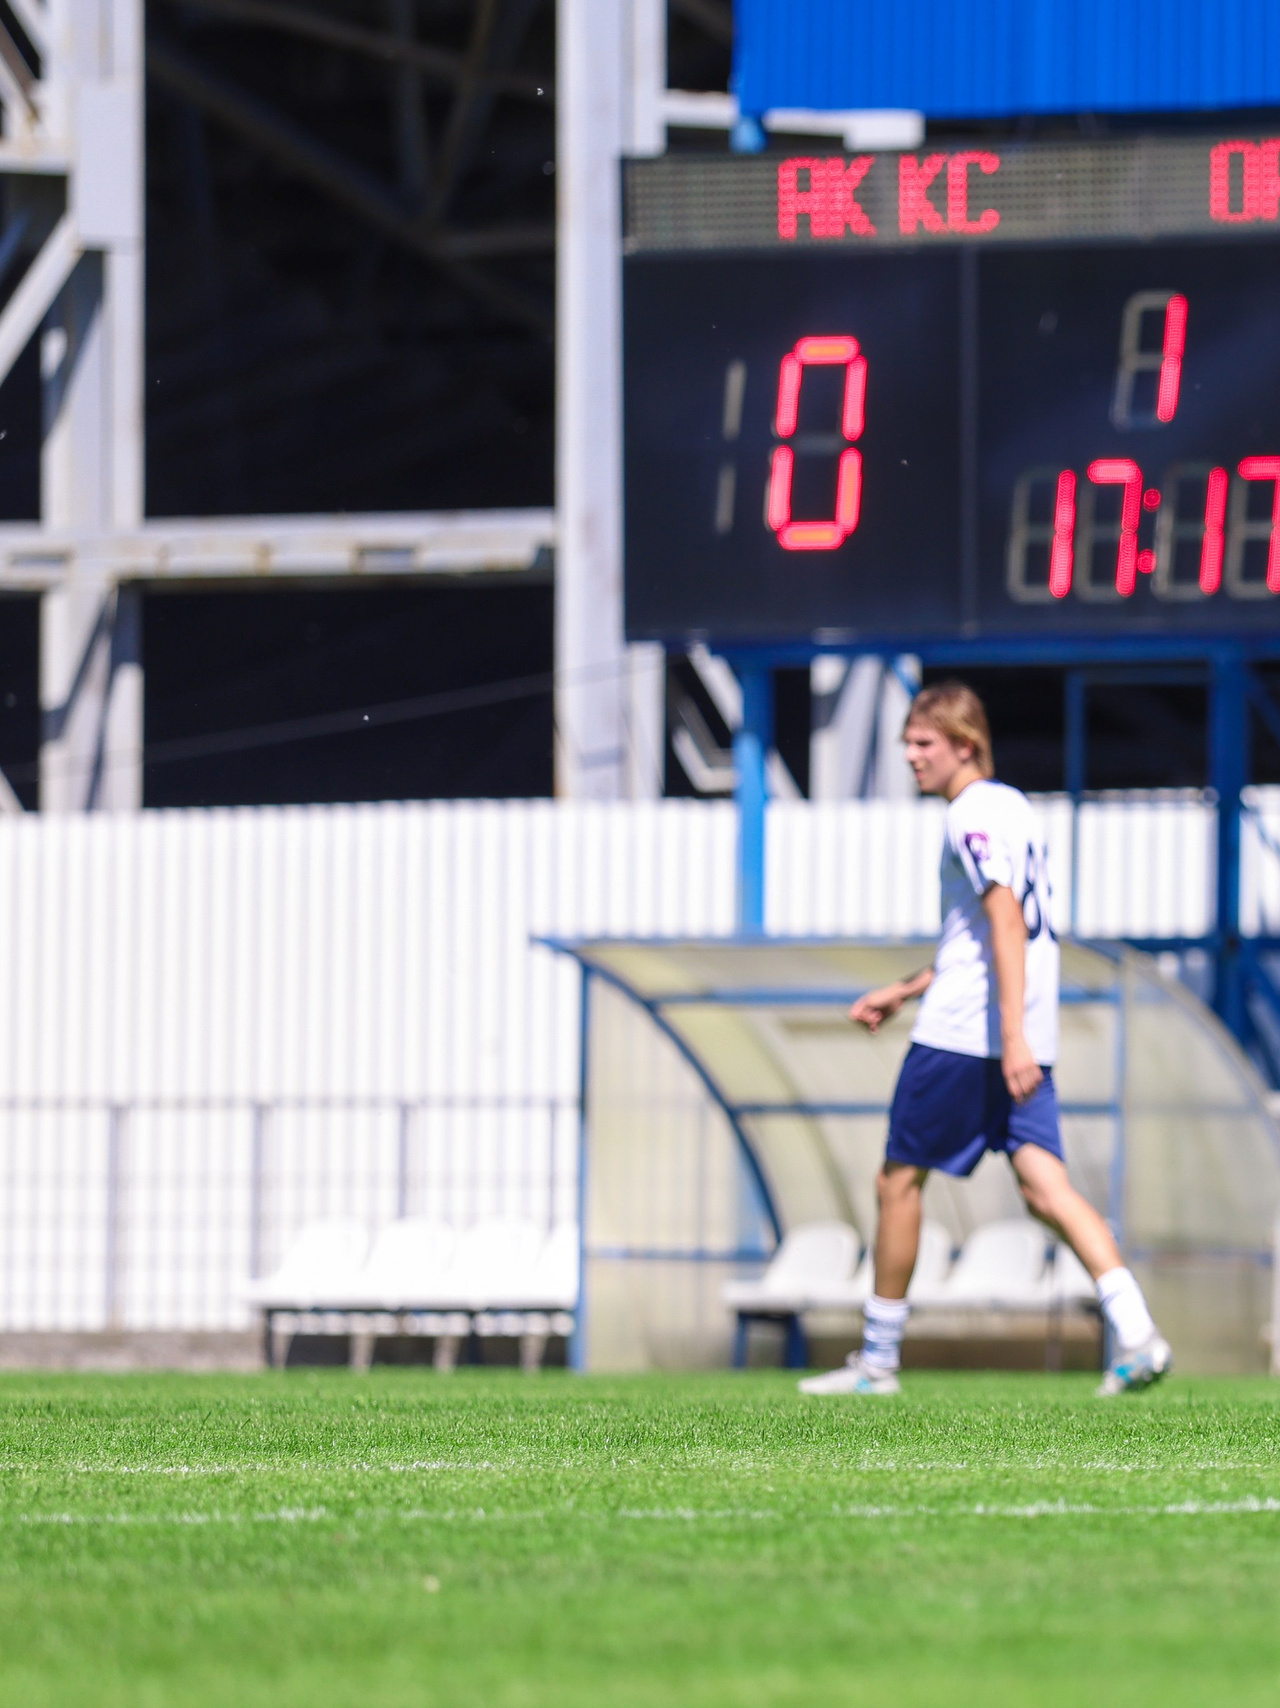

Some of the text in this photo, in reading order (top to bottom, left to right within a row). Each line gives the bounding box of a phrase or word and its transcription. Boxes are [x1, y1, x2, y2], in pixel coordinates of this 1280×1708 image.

[899, 151, 1000, 235] КС
[1156, 293, 1188, 423] 1
[768, 335, 868, 551] 0
